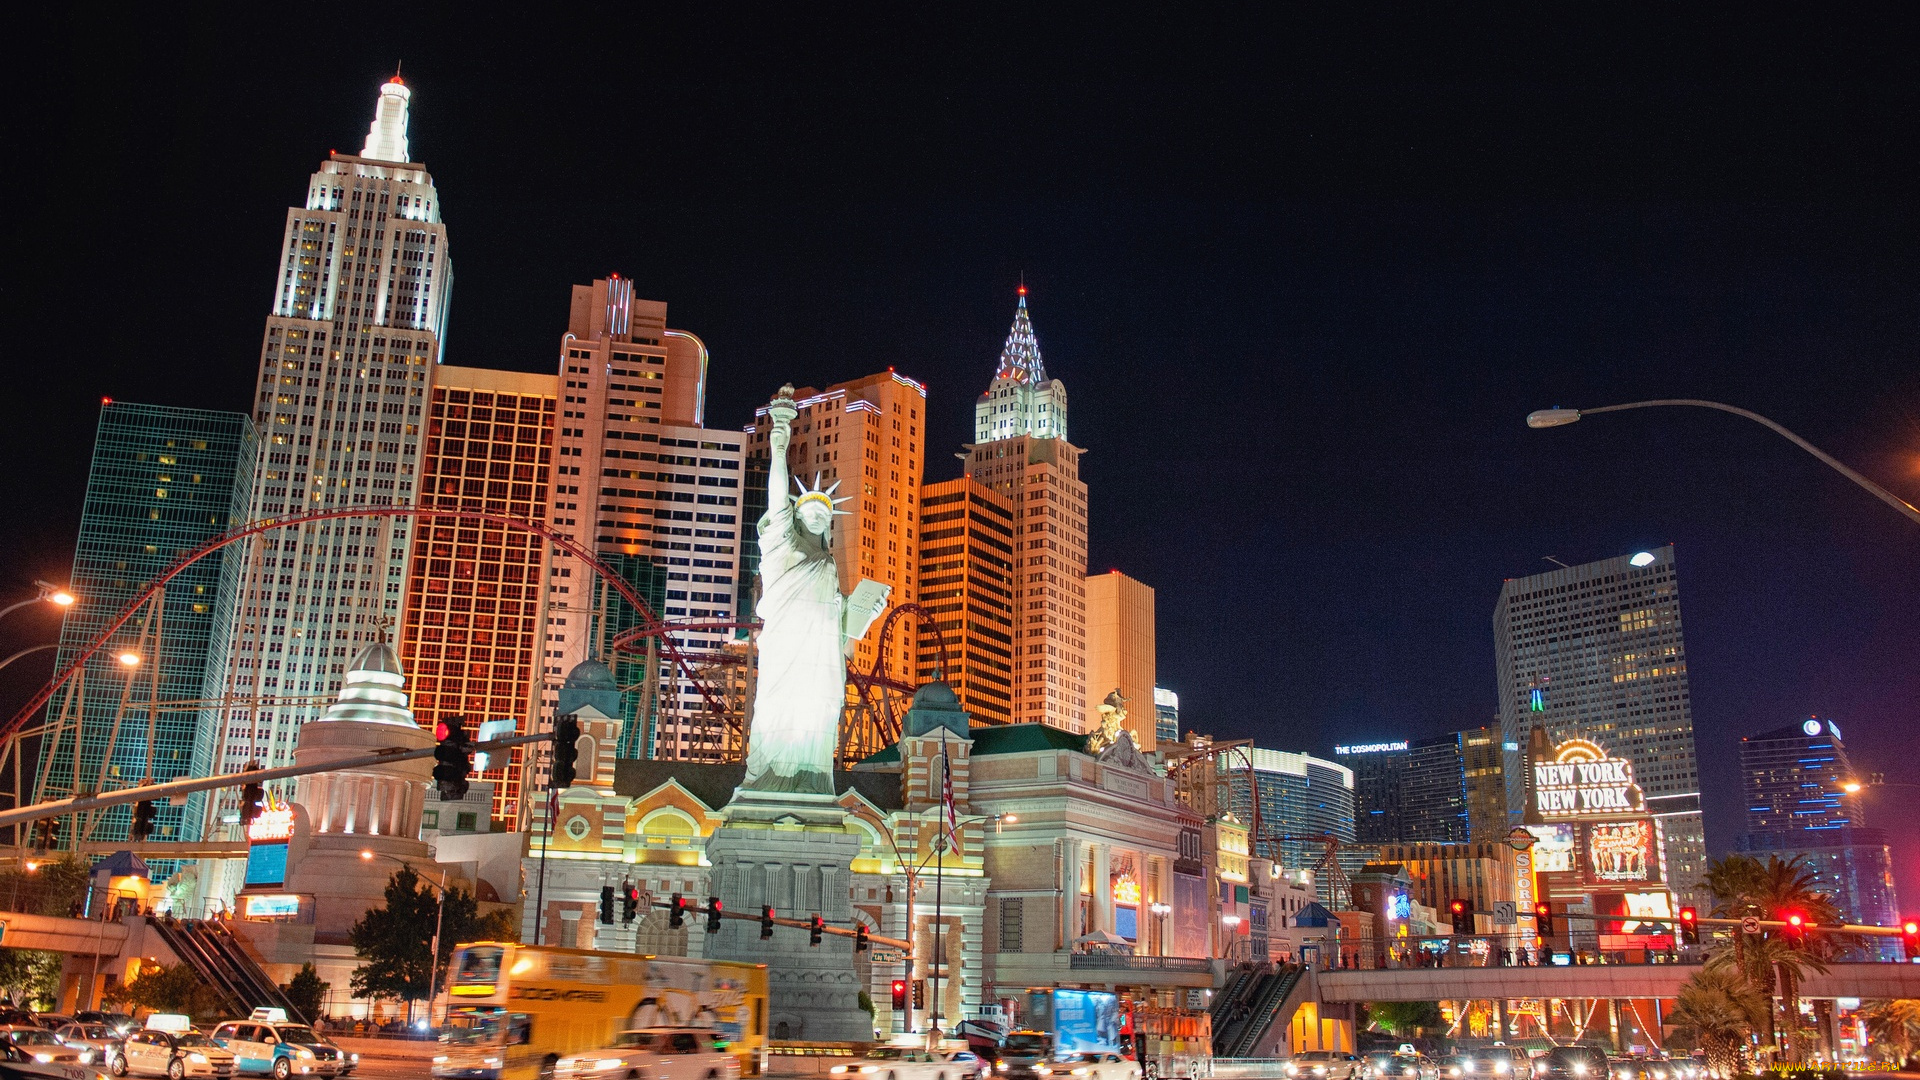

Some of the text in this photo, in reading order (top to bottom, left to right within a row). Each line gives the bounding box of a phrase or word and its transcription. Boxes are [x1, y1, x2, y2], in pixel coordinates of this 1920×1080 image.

[1335, 742, 1407, 754] THE COSMOPOLITAN
[1535, 762, 1628, 785] NEW YORK
[1537, 787, 1630, 811] NEW YORK
[1516, 853, 1534, 921] SPORTS
[62, 1068, 86, 1080] 7109
